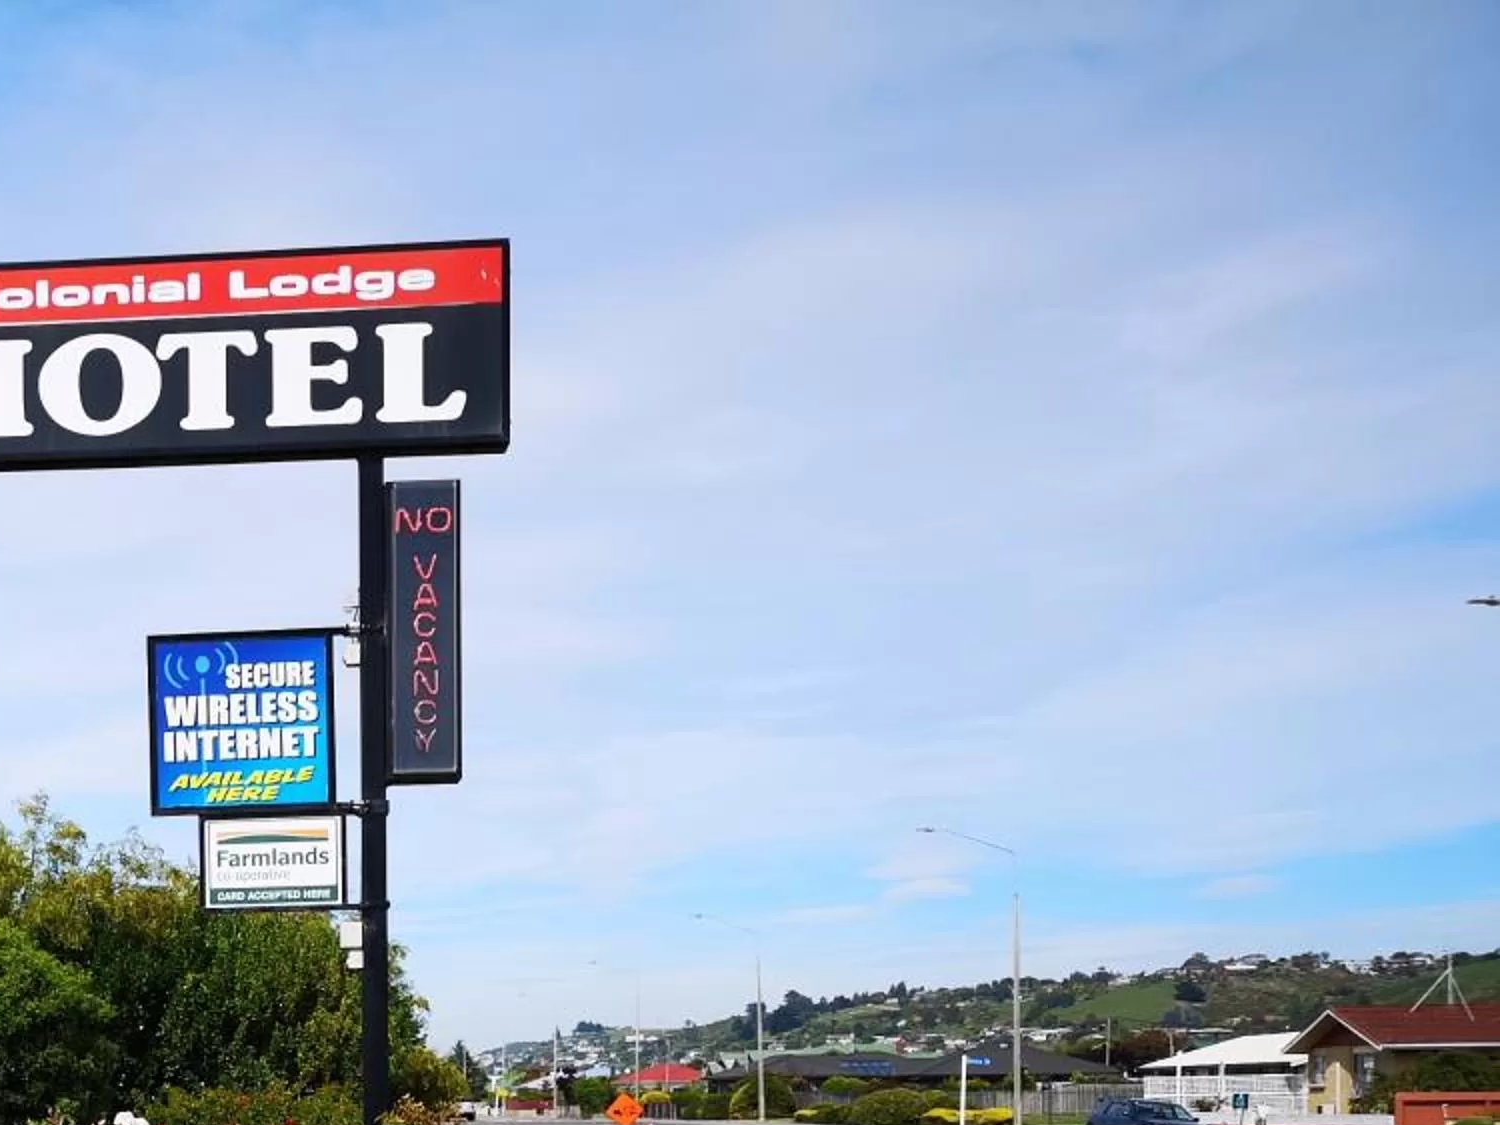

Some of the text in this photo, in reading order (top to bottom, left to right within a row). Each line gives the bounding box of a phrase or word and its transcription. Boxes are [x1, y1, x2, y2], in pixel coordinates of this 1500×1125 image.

[228, 265, 436, 300] Lodge
[394, 506, 452, 534] NO
[413, 552, 439, 752] VACANCY
[225, 661, 315, 688] SECURE
[163, 690, 319, 727] WIRELESS
[163, 726, 319, 763] INTERNET
[169, 765, 315, 793] AVAILABLE
[208, 785, 280, 803] HERE
[217, 847, 329, 868] Farmlands
[217, 888, 330, 901] CARD ACCEPTED HERE
